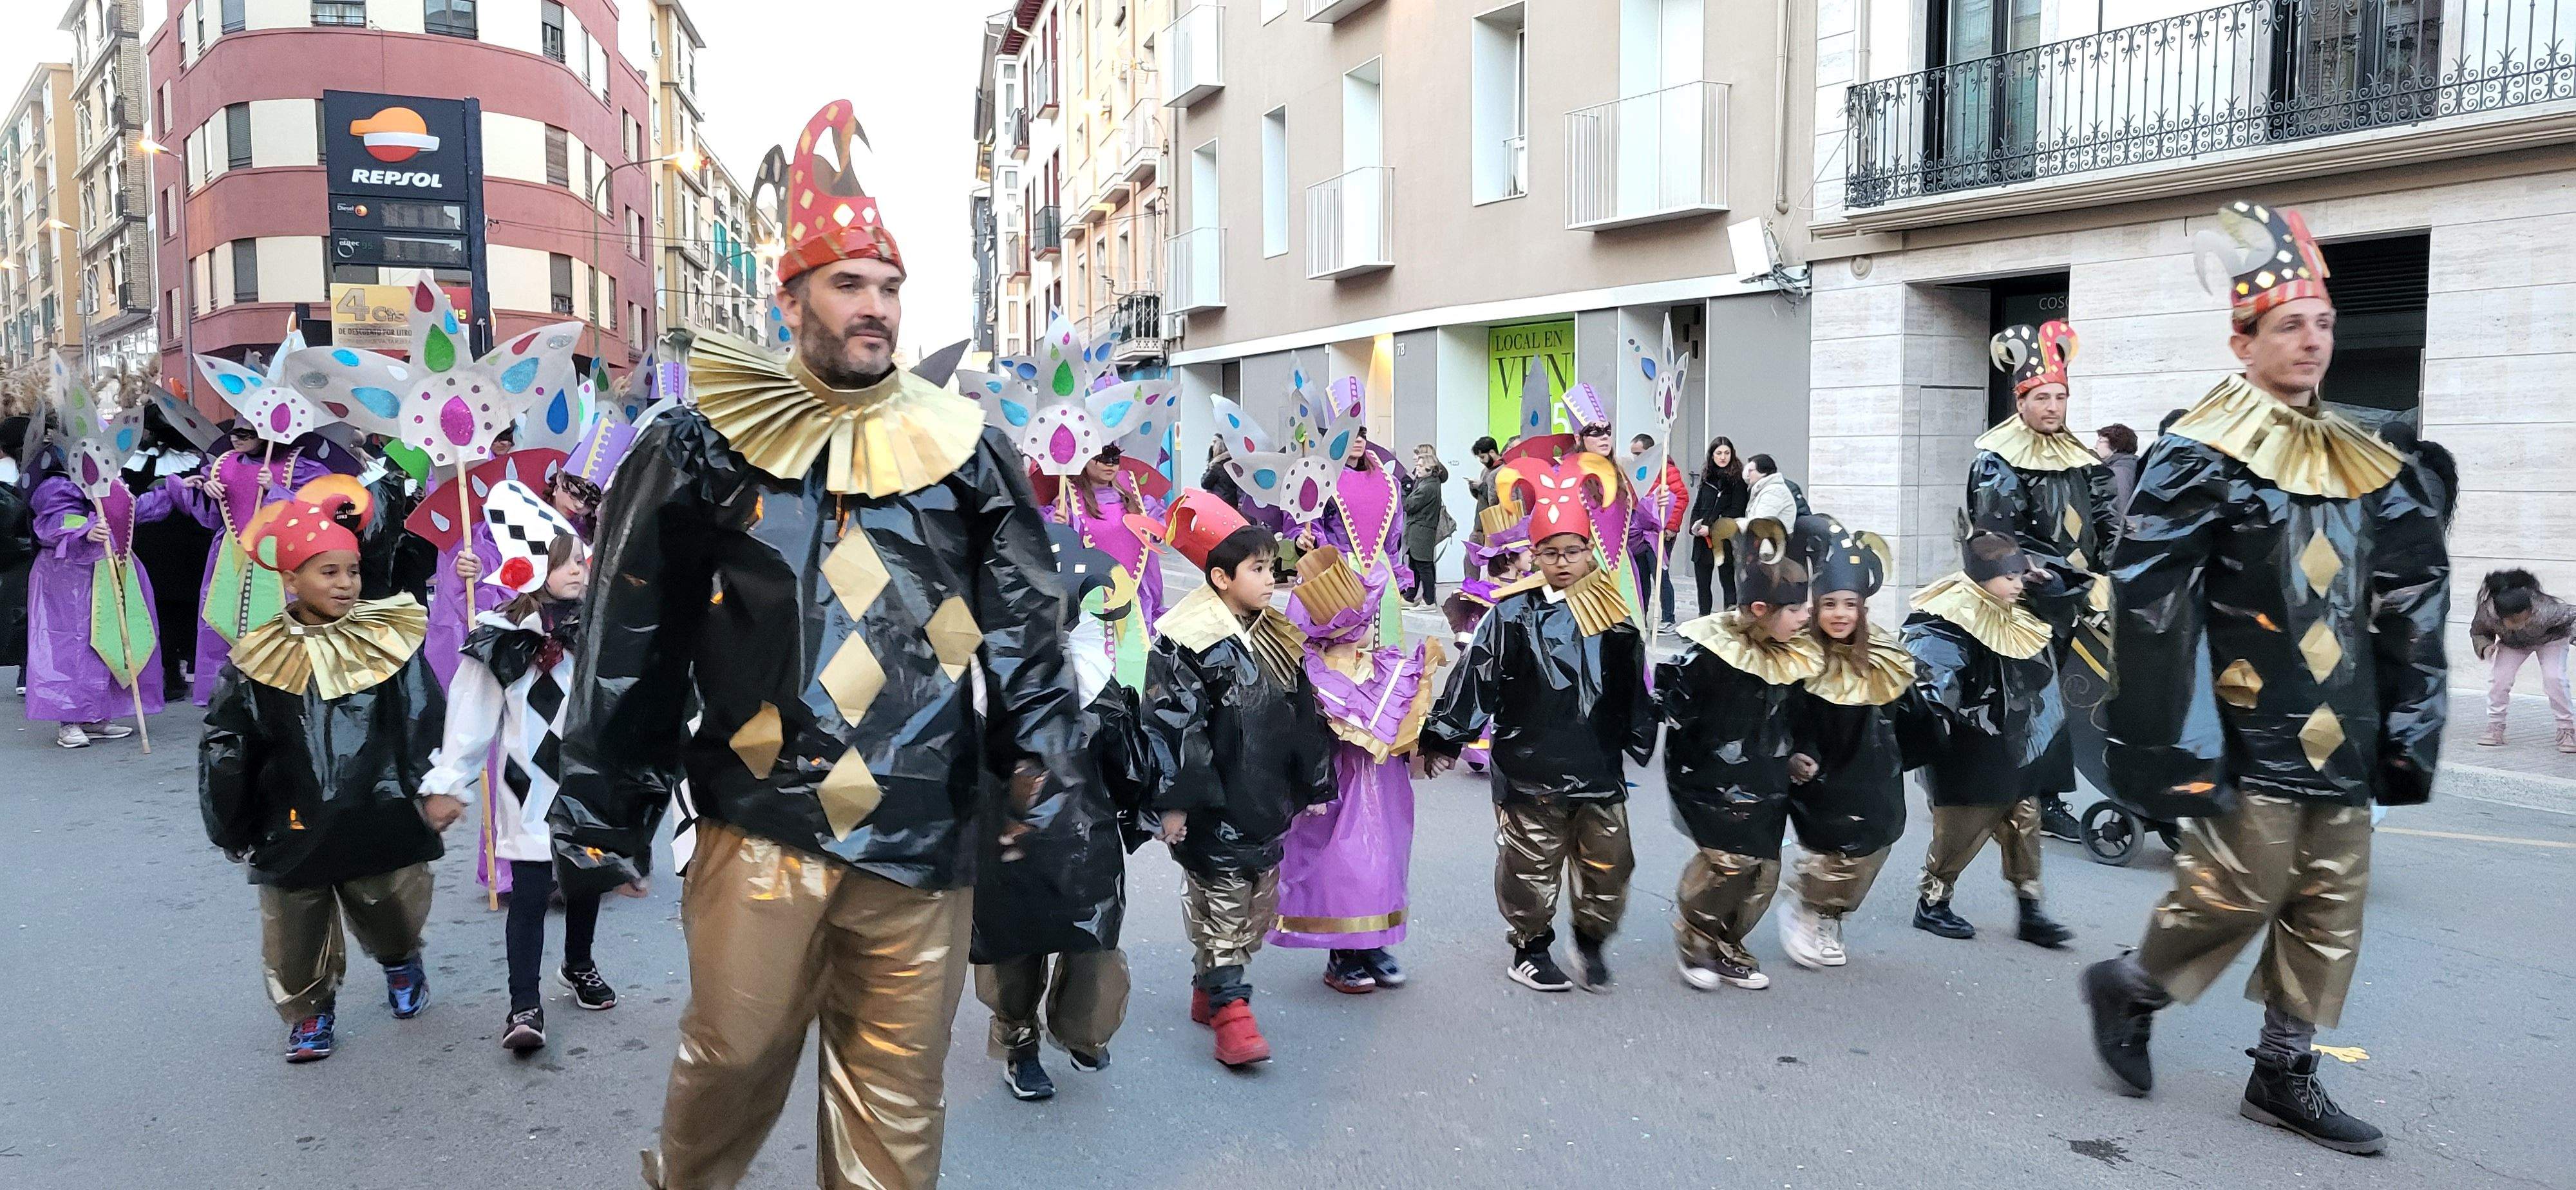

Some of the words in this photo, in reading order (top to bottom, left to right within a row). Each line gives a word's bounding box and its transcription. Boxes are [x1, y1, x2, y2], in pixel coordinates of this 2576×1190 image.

[352, 169, 442, 188] REPSOL
[336, 288, 370, 321] 4
[1397, 343, 1405, 356] 78
[1495, 332, 1540, 352] LOCAL
[1544, 330, 1563, 348] EN
[1495, 352, 1575, 399] VEN
